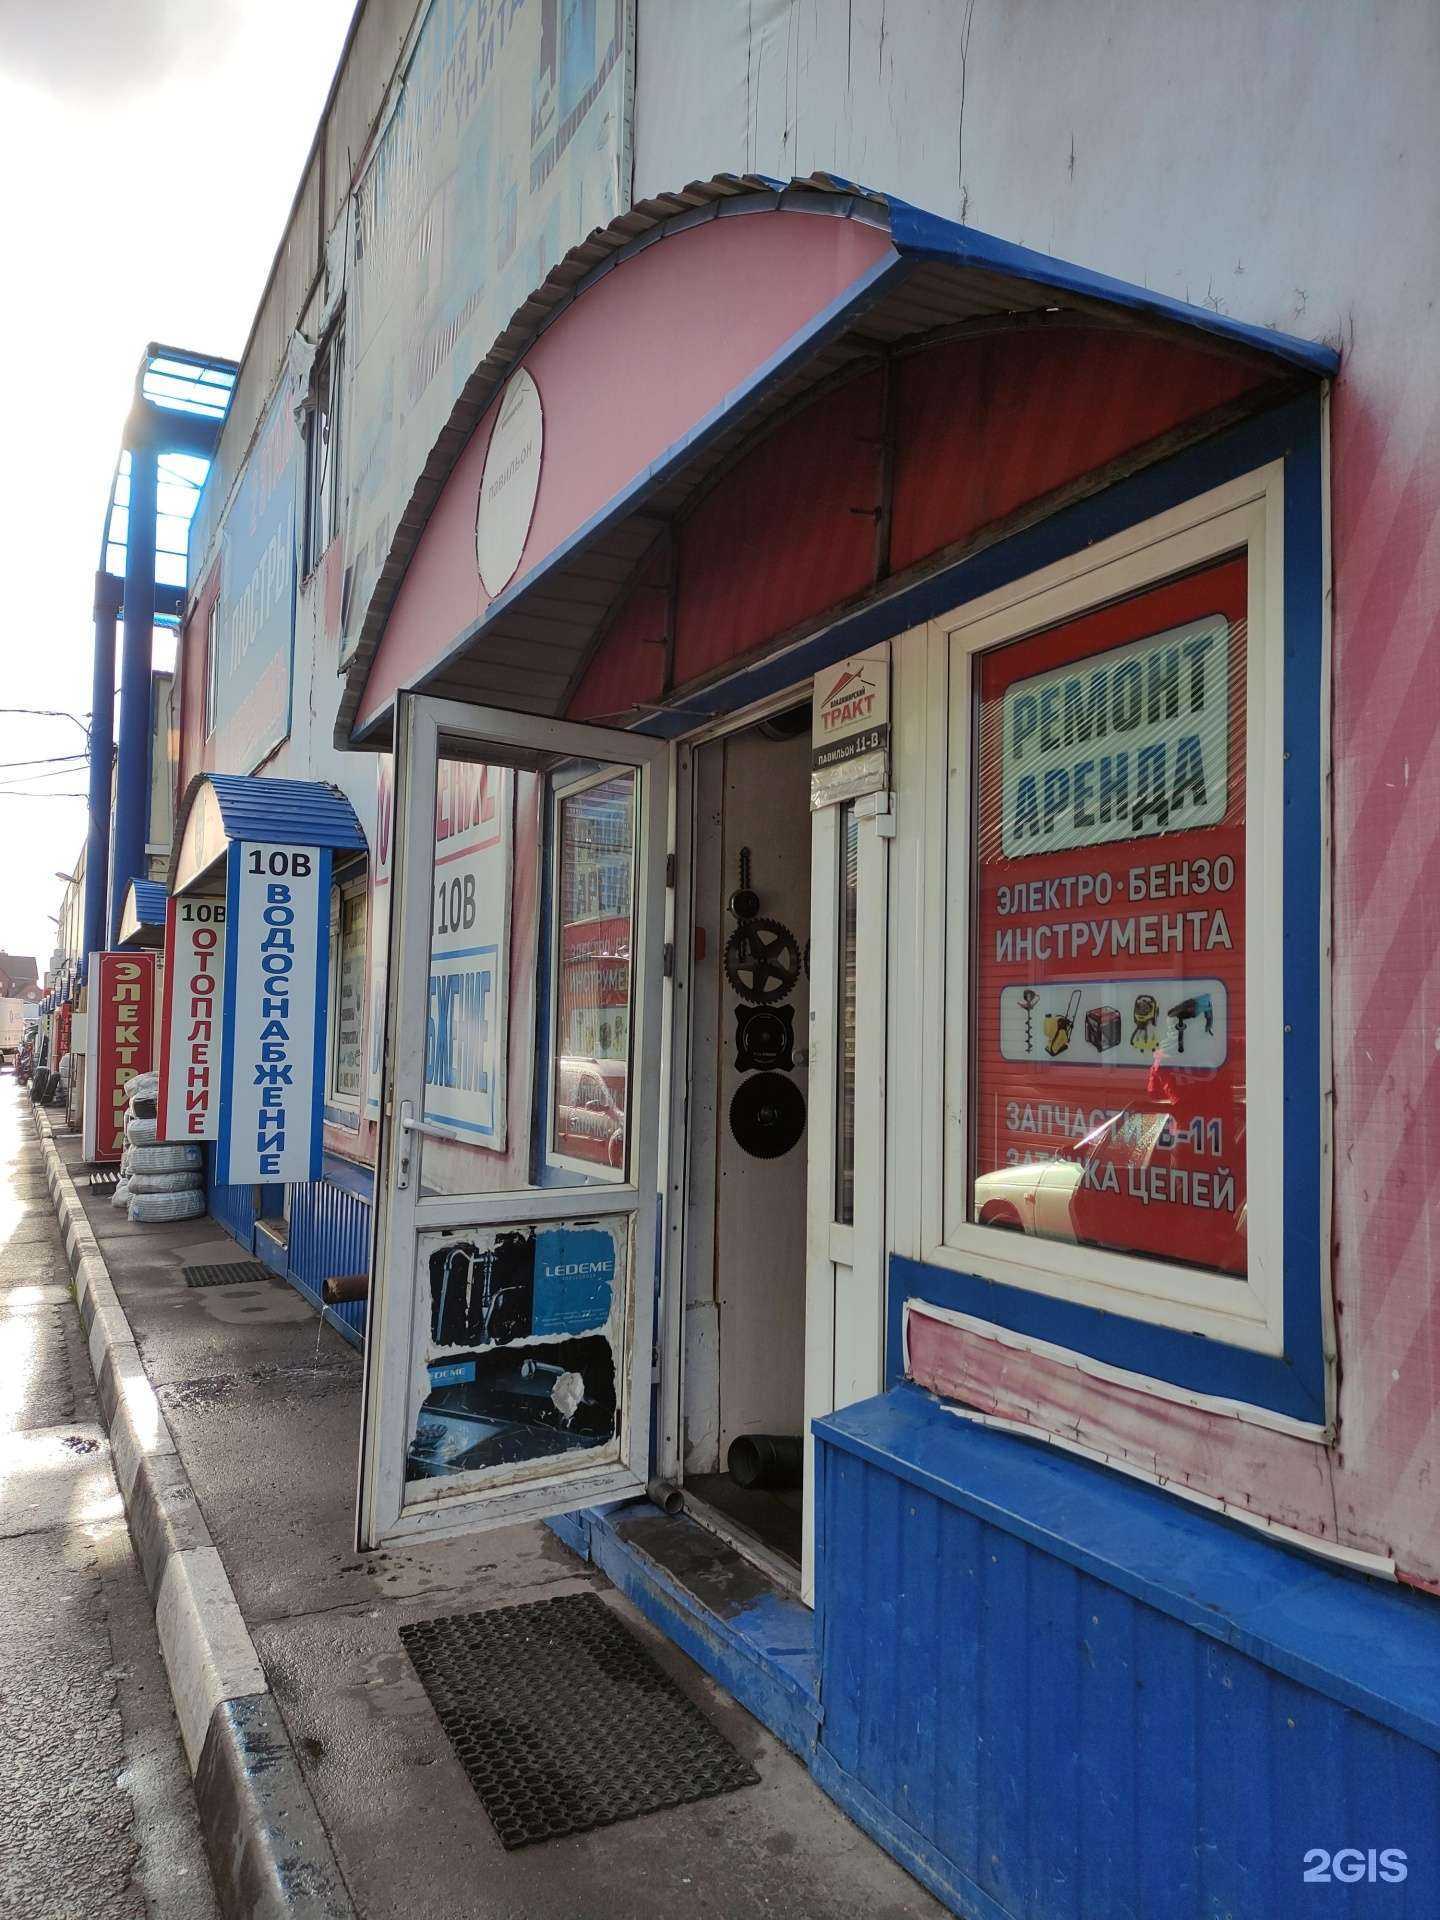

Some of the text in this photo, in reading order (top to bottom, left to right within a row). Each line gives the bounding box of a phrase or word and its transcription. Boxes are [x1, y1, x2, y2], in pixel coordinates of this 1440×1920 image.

[821, 693, 876, 731] ТРАКТ
[1012, 635, 1214, 759] РЕМОНТ
[818, 732, 879, 766] ПАВИЛЬОН 11-В
[1013, 734, 1208, 839] АРЕНДА
[247, 849, 312, 877] 10В
[995, 908, 1233, 963] ИНСТРУМЕНТА
[185, 928, 218, 1134] ОТОПЛЕНИЕ
[253, 883, 295, 1175] ВОДОСНАБЖЕНИЕ
[1005, 1102, 1144, 1147] ЗАПЧАСТИ
[1128, 1166, 1235, 1212] ЦЕПЕЙ
[545, 1260, 613, 1277] LEDEME
